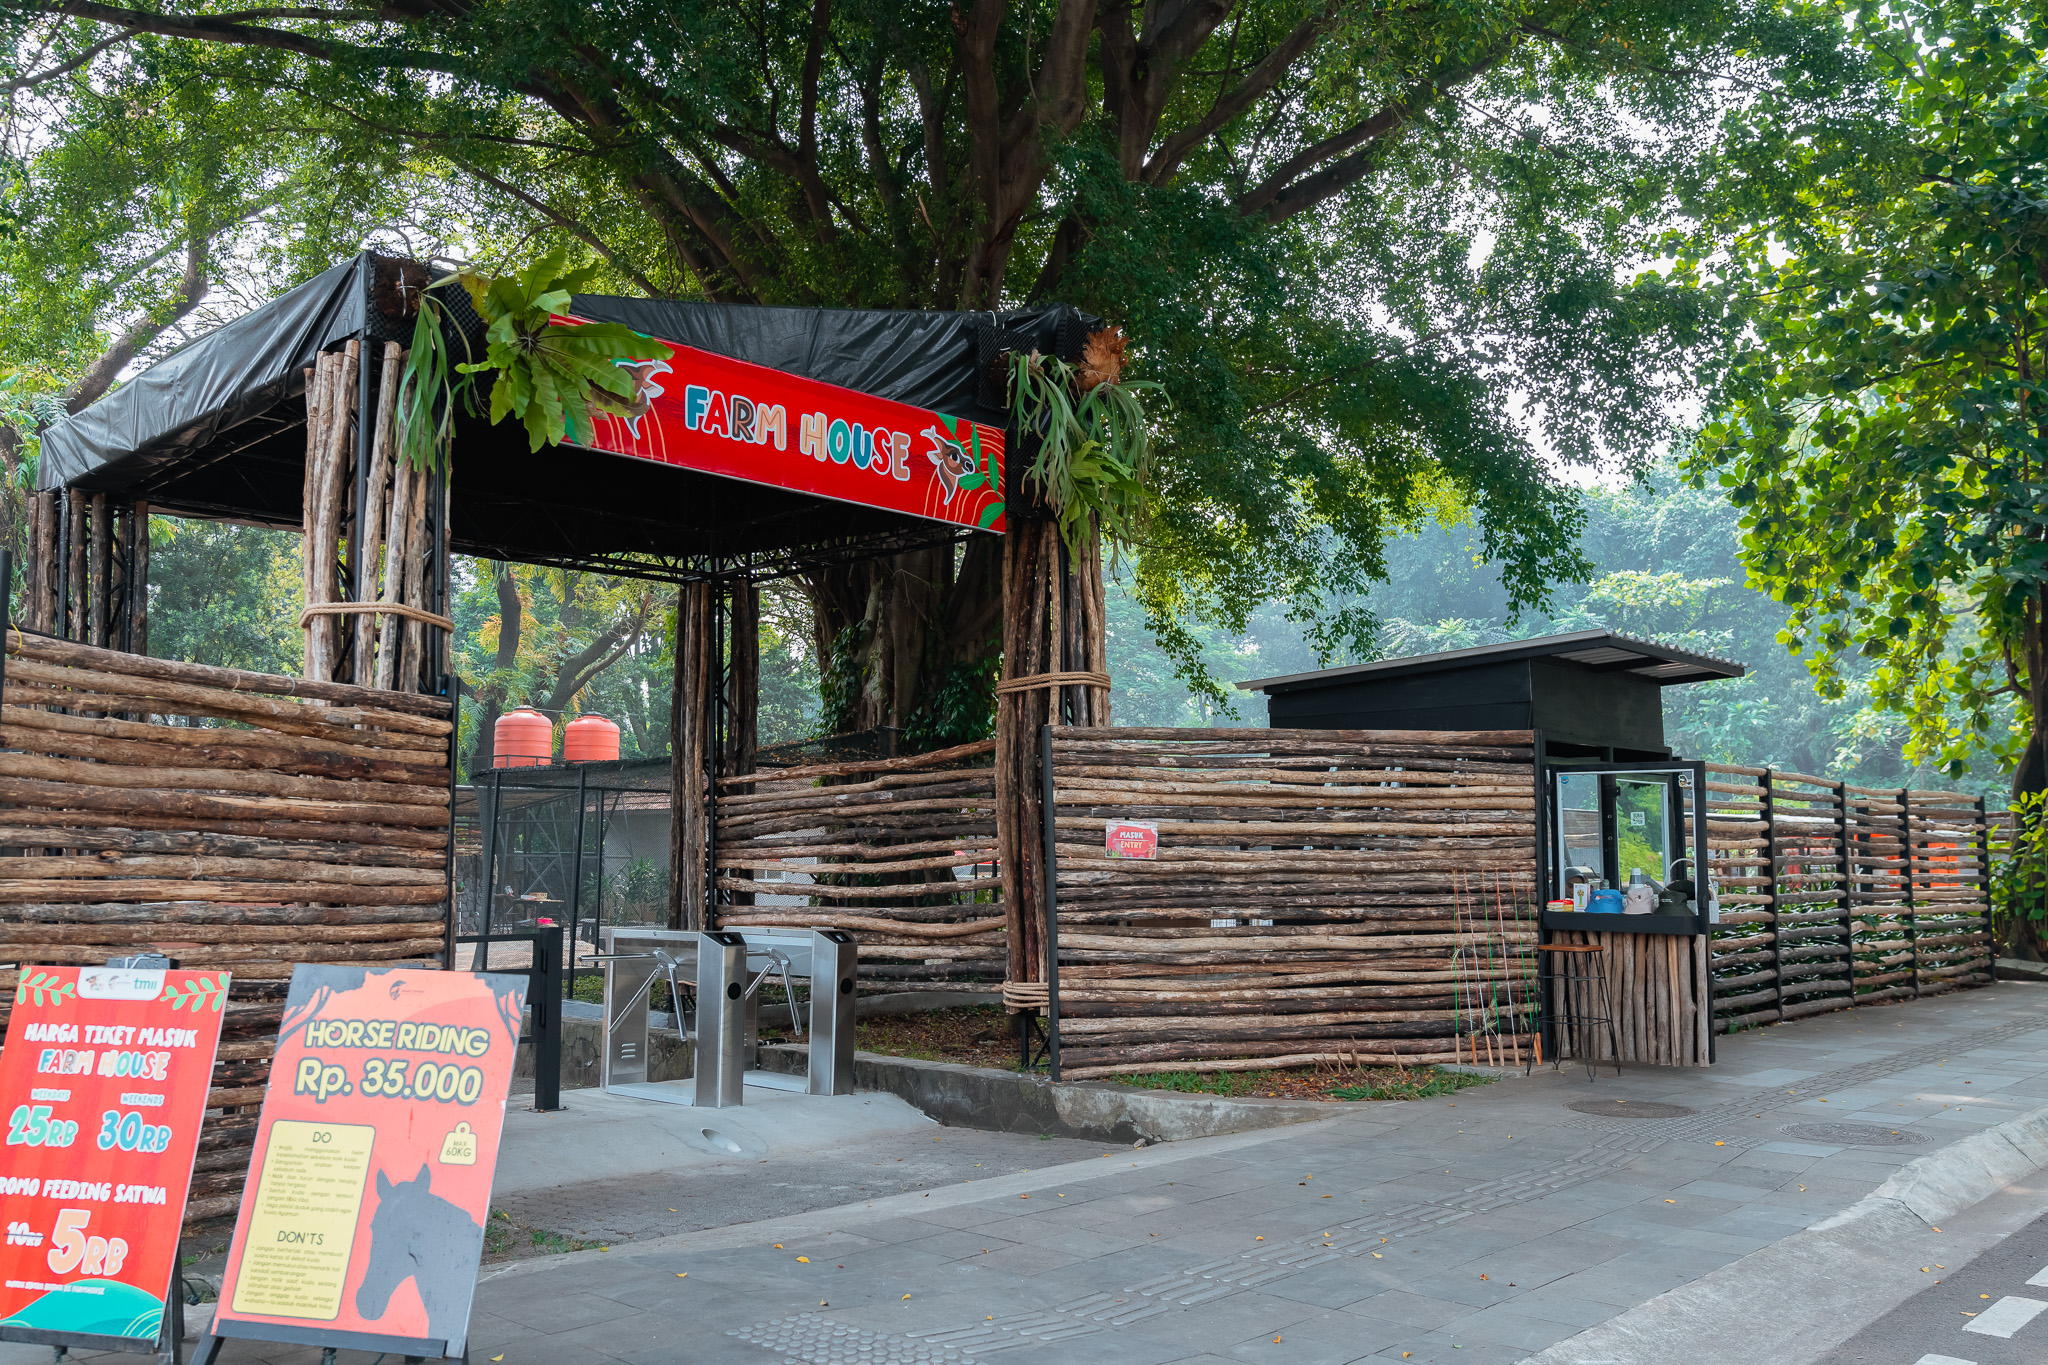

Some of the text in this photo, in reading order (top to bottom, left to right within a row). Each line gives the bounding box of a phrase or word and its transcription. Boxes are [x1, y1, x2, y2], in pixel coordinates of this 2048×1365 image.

[684, 384, 910, 481] FARM HOUSE
[1120, 831, 1143, 839] MASUK
[24, 1022, 198, 1048] HARGA TIKET MASUK
[304, 1019, 490, 1057] HORSE RIDING
[38, 1049, 171, 1080] FARM HOUSE
[294, 1057, 484, 1106] Rp. 35.000
[121, 1093, 165, 1107] WEEKENDS
[6, 1105, 79, 1148] 25RB
[97, 1110, 172, 1153] 30RB
[312, 1132, 331, 1143] DO
[446, 1147, 471, 1157] 60KG
[0, 1177, 166, 1205] ROMO FEEDING SATWA
[47, 1208, 128, 1276] 5RB
[277, 1230, 324, 1245] DON'TS
